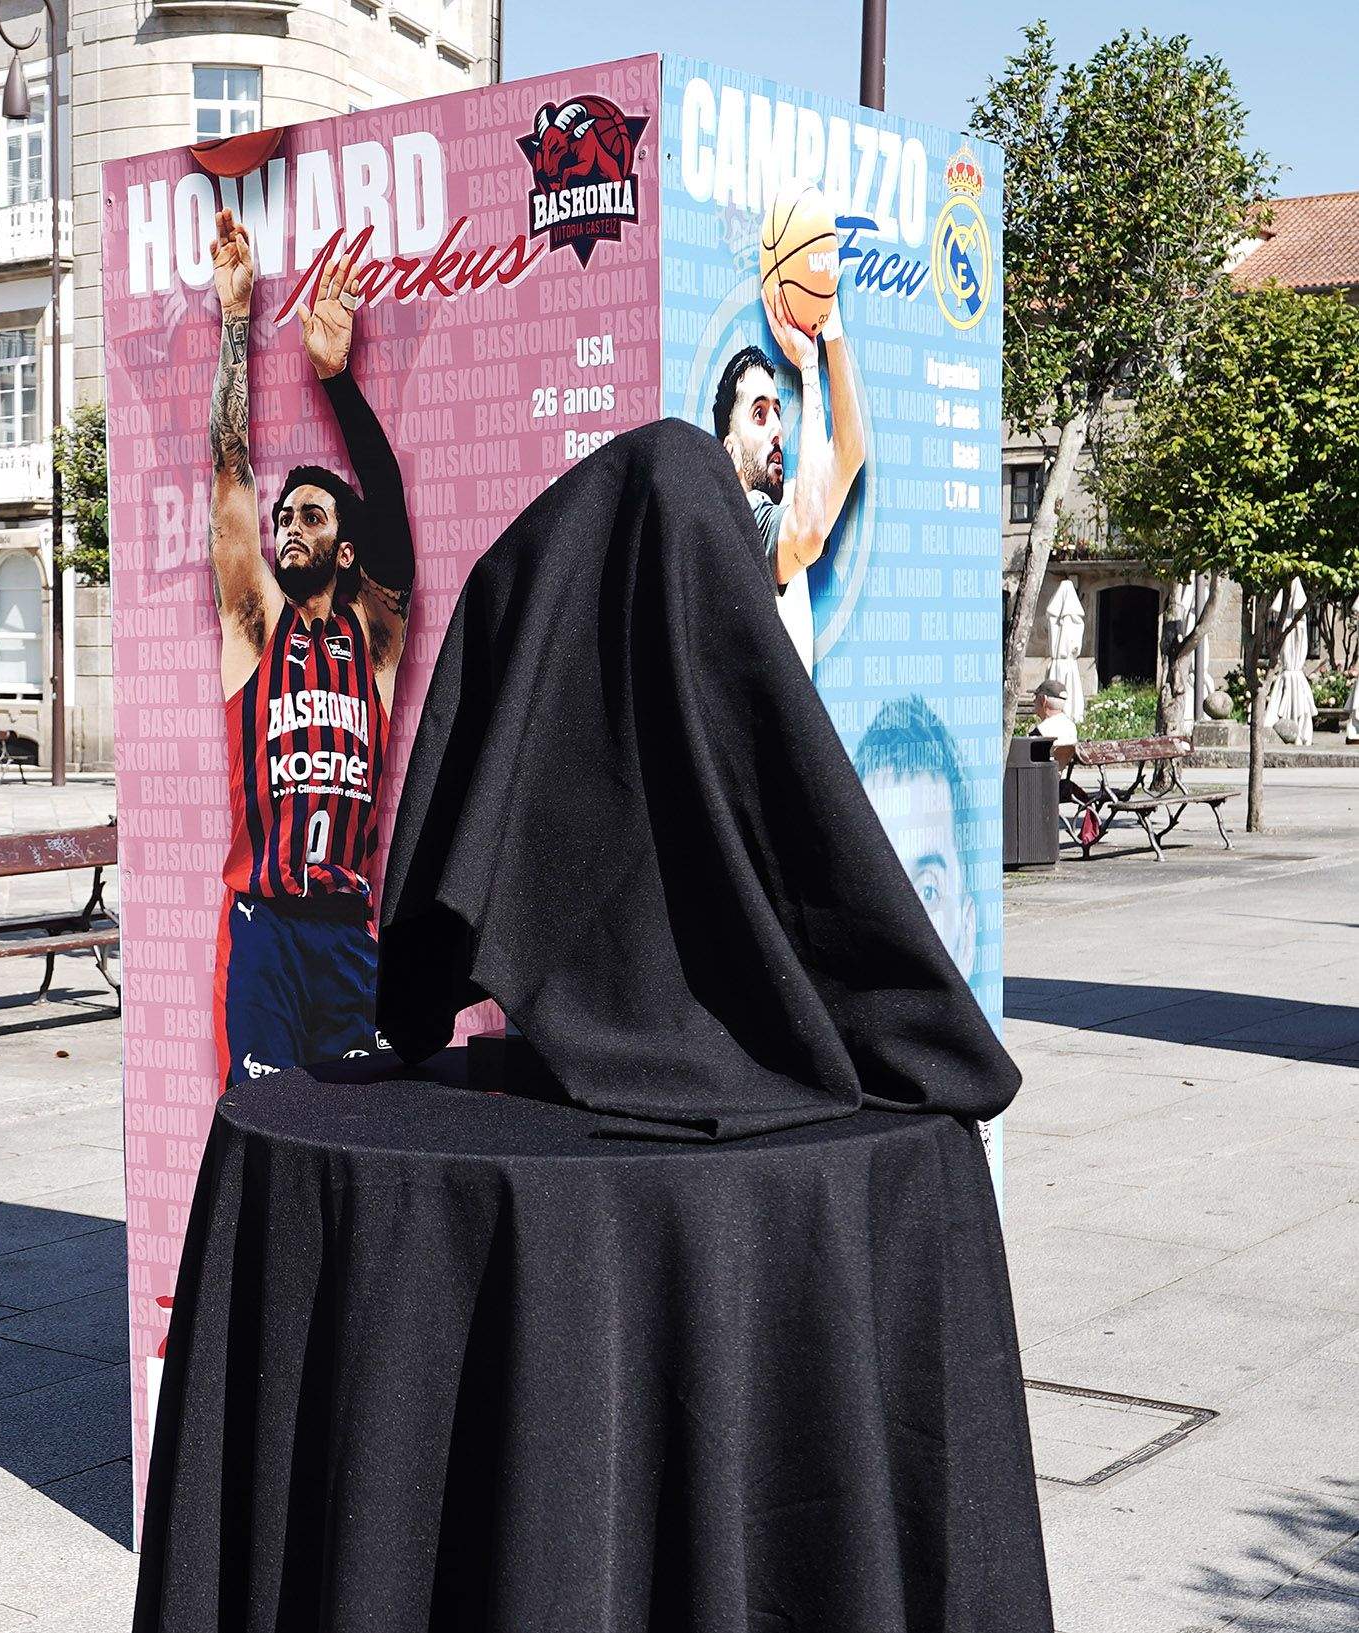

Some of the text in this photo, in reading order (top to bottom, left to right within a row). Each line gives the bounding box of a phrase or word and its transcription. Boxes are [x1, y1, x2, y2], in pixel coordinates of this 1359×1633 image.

[464, 78, 573, 133] BASKONIA
[681, 77, 928, 249] CAMPAZZO
[128, 131, 448, 295] HOWARD
[533, 179, 635, 231] BASKONIA
[553, 222, 584, 242] VITORIA
[273, 216, 547, 327] Markus
[664, 256, 699, 297] REAL
[835, 216, 930, 299] Facu
[539, 266, 649, 315] BASKONIA
[473, 315, 578, 362] BASKONIA
[576, 334, 615, 368] USA
[864, 339, 913, 377] MADRID
[418, 362, 521, 406] BASKONIA
[532, 384, 616, 418] 26 anos
[420, 438, 522, 481] BASKONIA
[922, 523, 999, 557] REAL MADRID
[895, 567, 942, 598] MADRID
[952, 567, 980, 598] REAL
[863, 611, 911, 641] MADRID
[921, 611, 999, 641] REAL MADRID
[863, 654, 943, 687] REAL MADRID
[954, 653, 981, 684] REAL
[267, 690, 369, 747] BASKONIA
[953, 695, 999, 725] MADRID
[306, 809, 330, 865] 0
